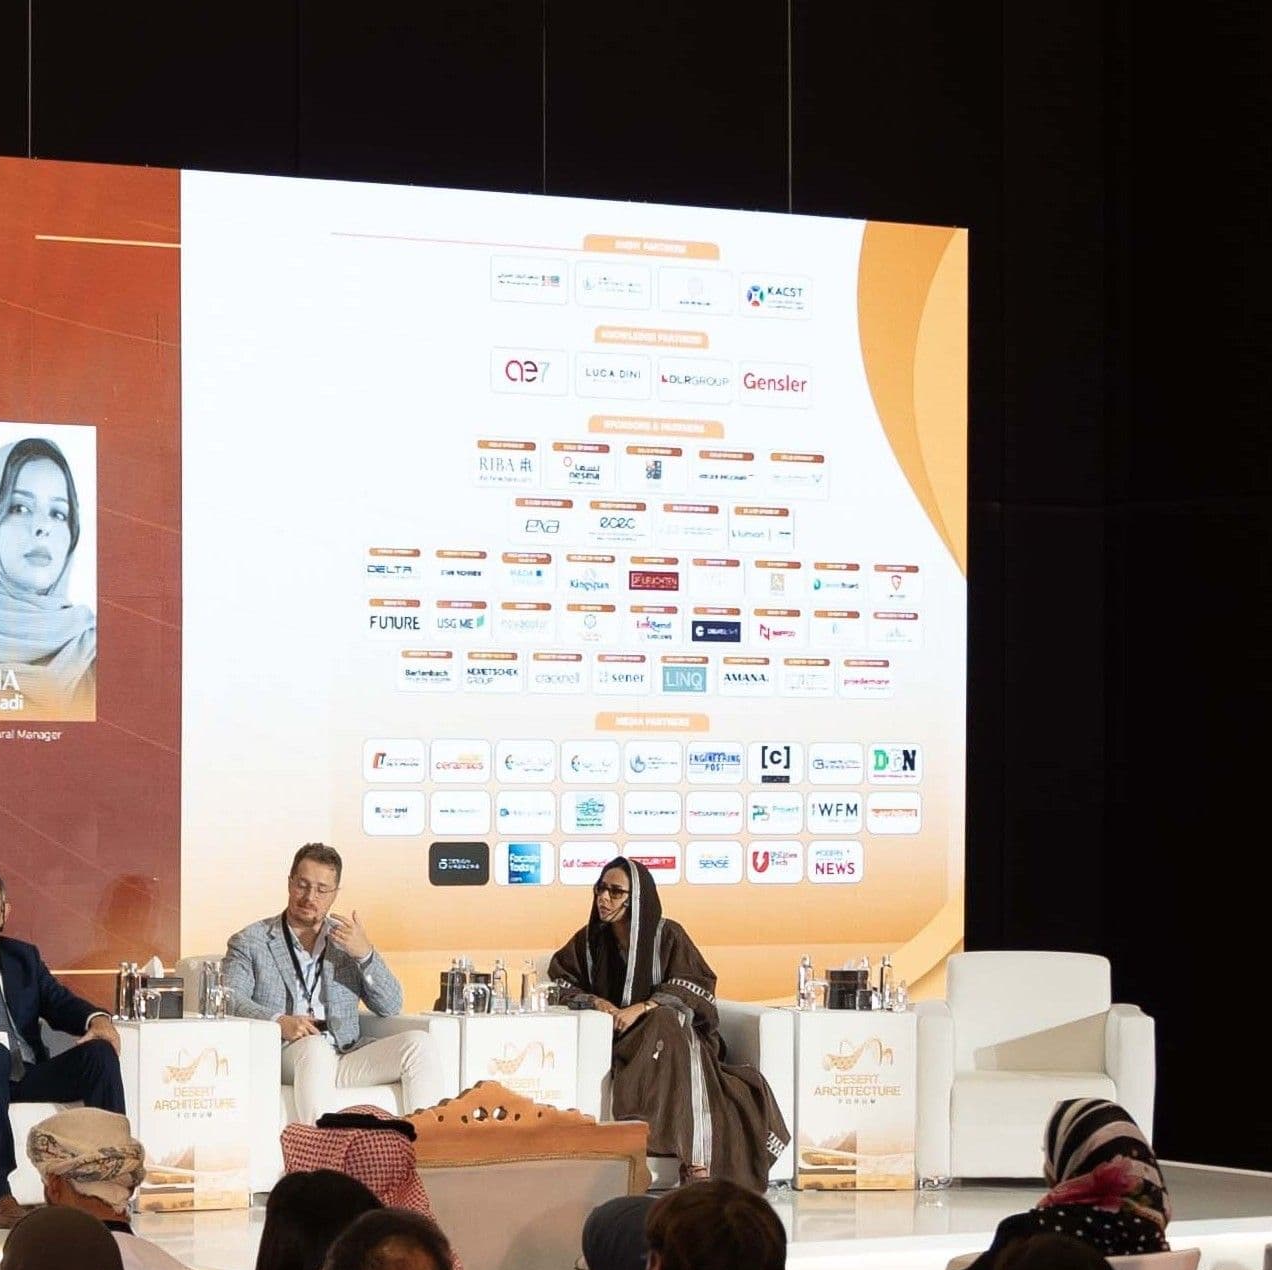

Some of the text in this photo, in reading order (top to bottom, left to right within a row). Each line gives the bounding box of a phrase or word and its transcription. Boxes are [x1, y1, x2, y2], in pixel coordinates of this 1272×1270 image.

[743, 372, 808, 393] Gensler
[479, 457, 515, 472] RIBA
[367, 564, 413, 574] DELTA
[612, 672, 645, 683] sener
[665, 671, 702, 688] LINQ
[17, 729, 62, 742] Manager
[815, 862, 855, 875] NEWS
[834, 1074, 880, 1084] DESERT
[813, 1085, 902, 1097] ARCHITECTURE
[153, 1098, 237, 1111] ARCHITECTURE
